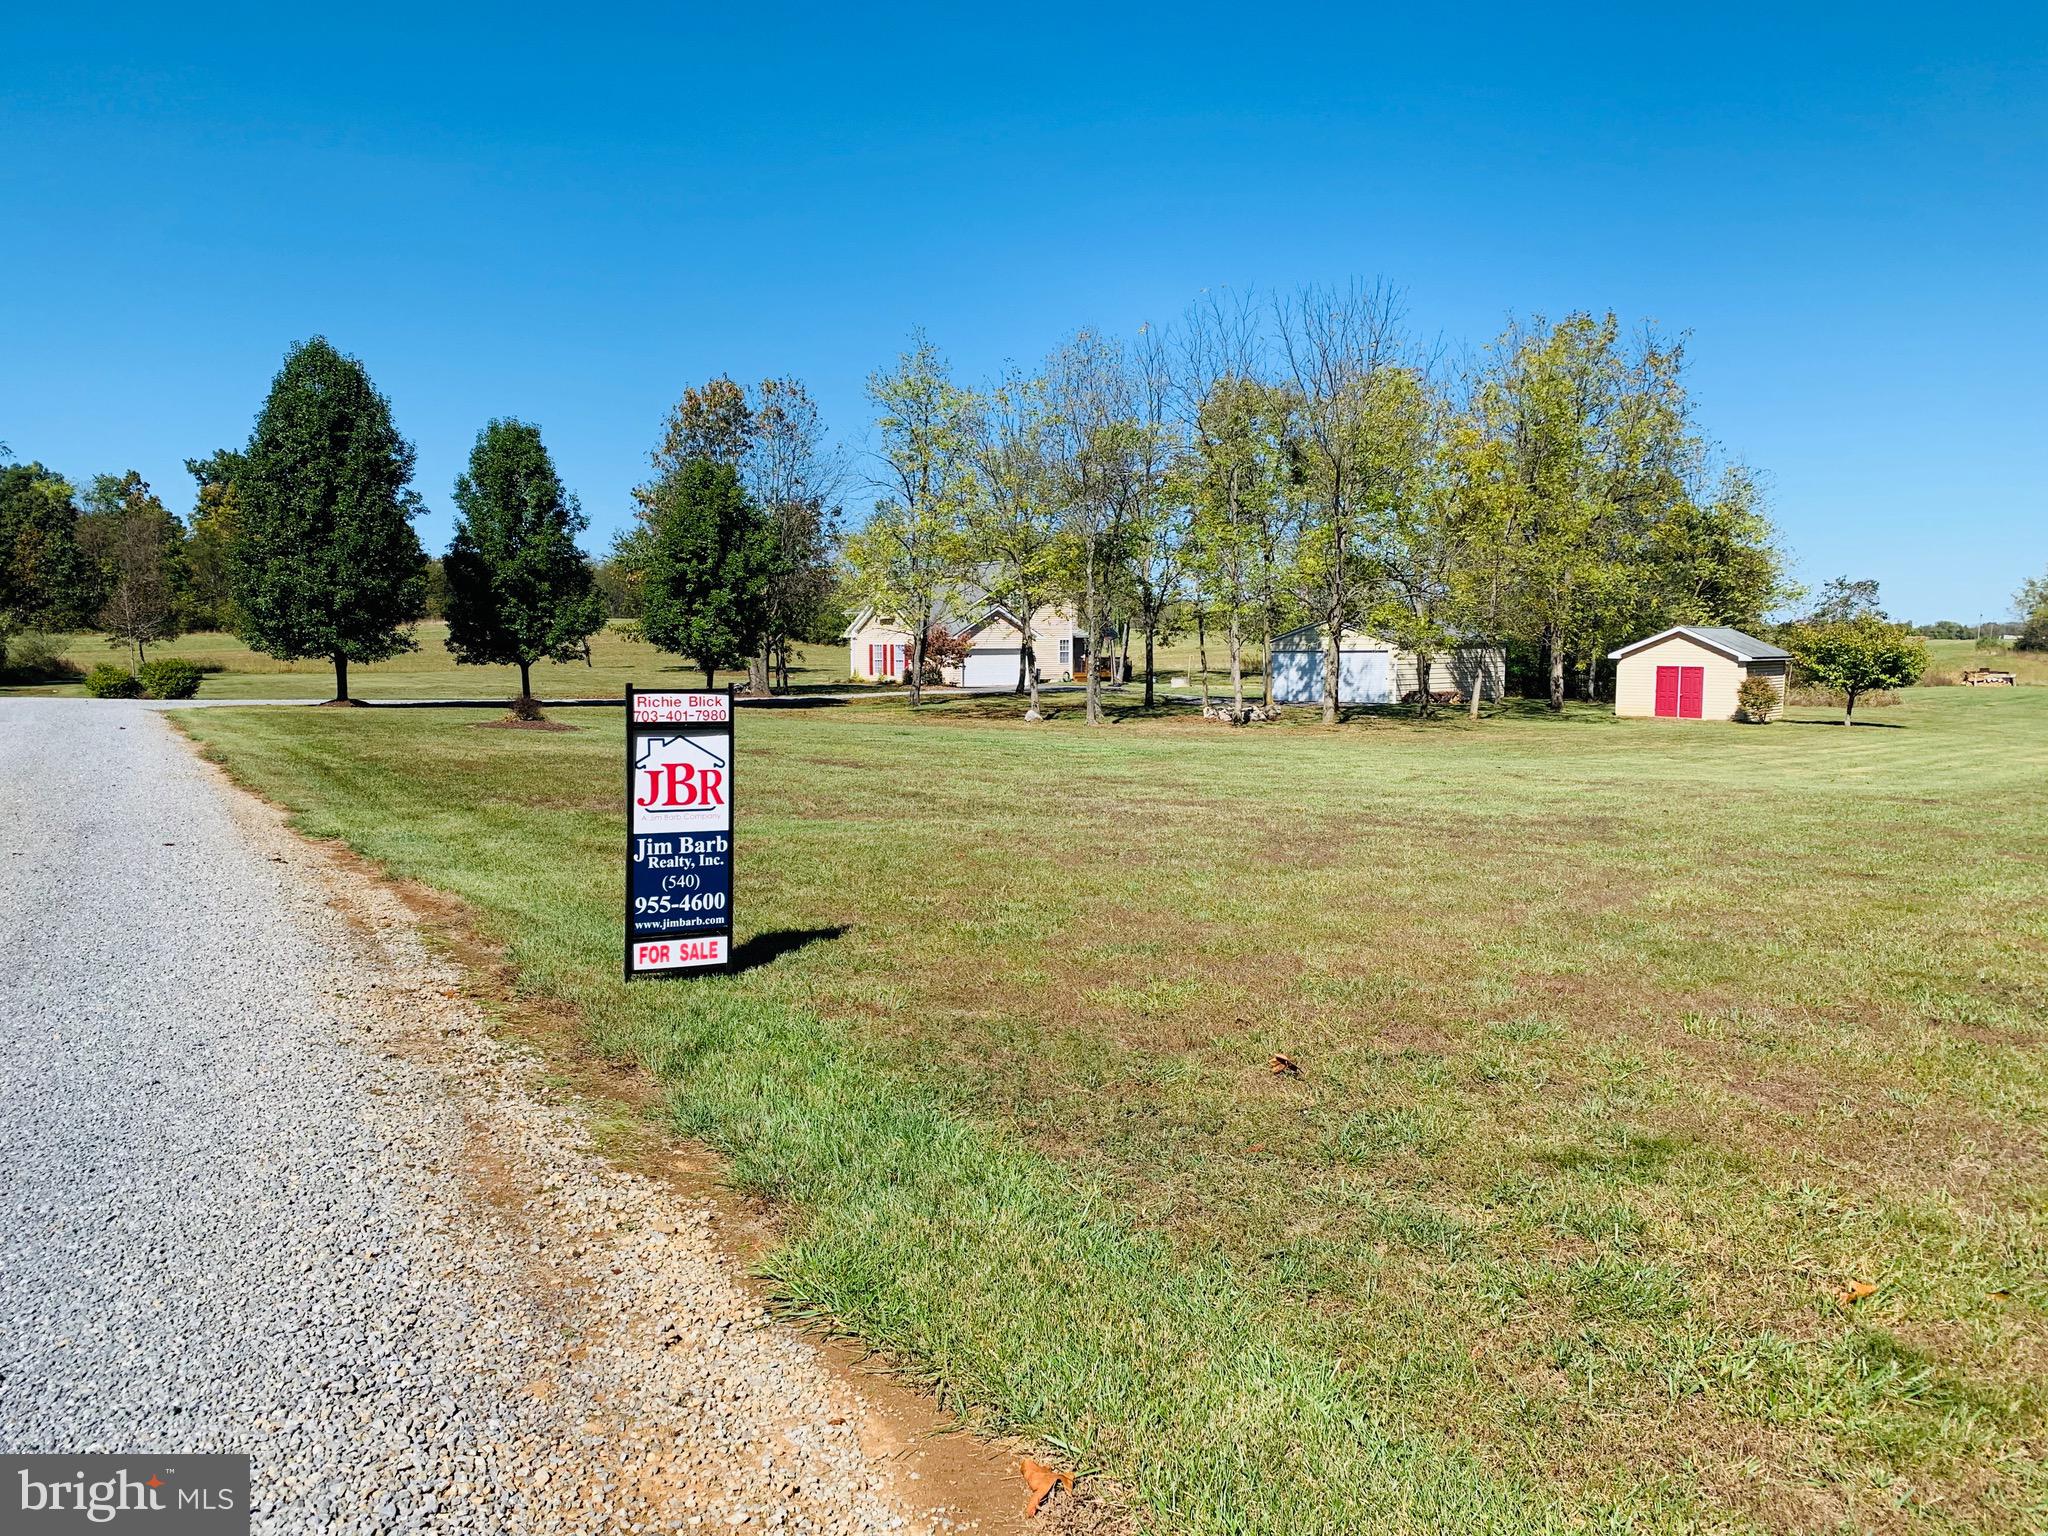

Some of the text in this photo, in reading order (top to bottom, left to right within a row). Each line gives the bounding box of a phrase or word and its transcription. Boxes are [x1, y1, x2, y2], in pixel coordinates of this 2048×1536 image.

[637, 696, 723, 708] Richie Blick
[634, 710, 727, 723] 703-401-7980
[637, 763, 725, 807] JBR
[633, 835, 729, 862] Jim Barb
[648, 854, 725, 870] Realty, Inc.
[662, 873, 700, 892] (540)
[635, 892, 726, 915] 955-4600
[635, 916, 725, 930] www.jimbarb.com
[639, 941, 719, 964] FOR SALE
